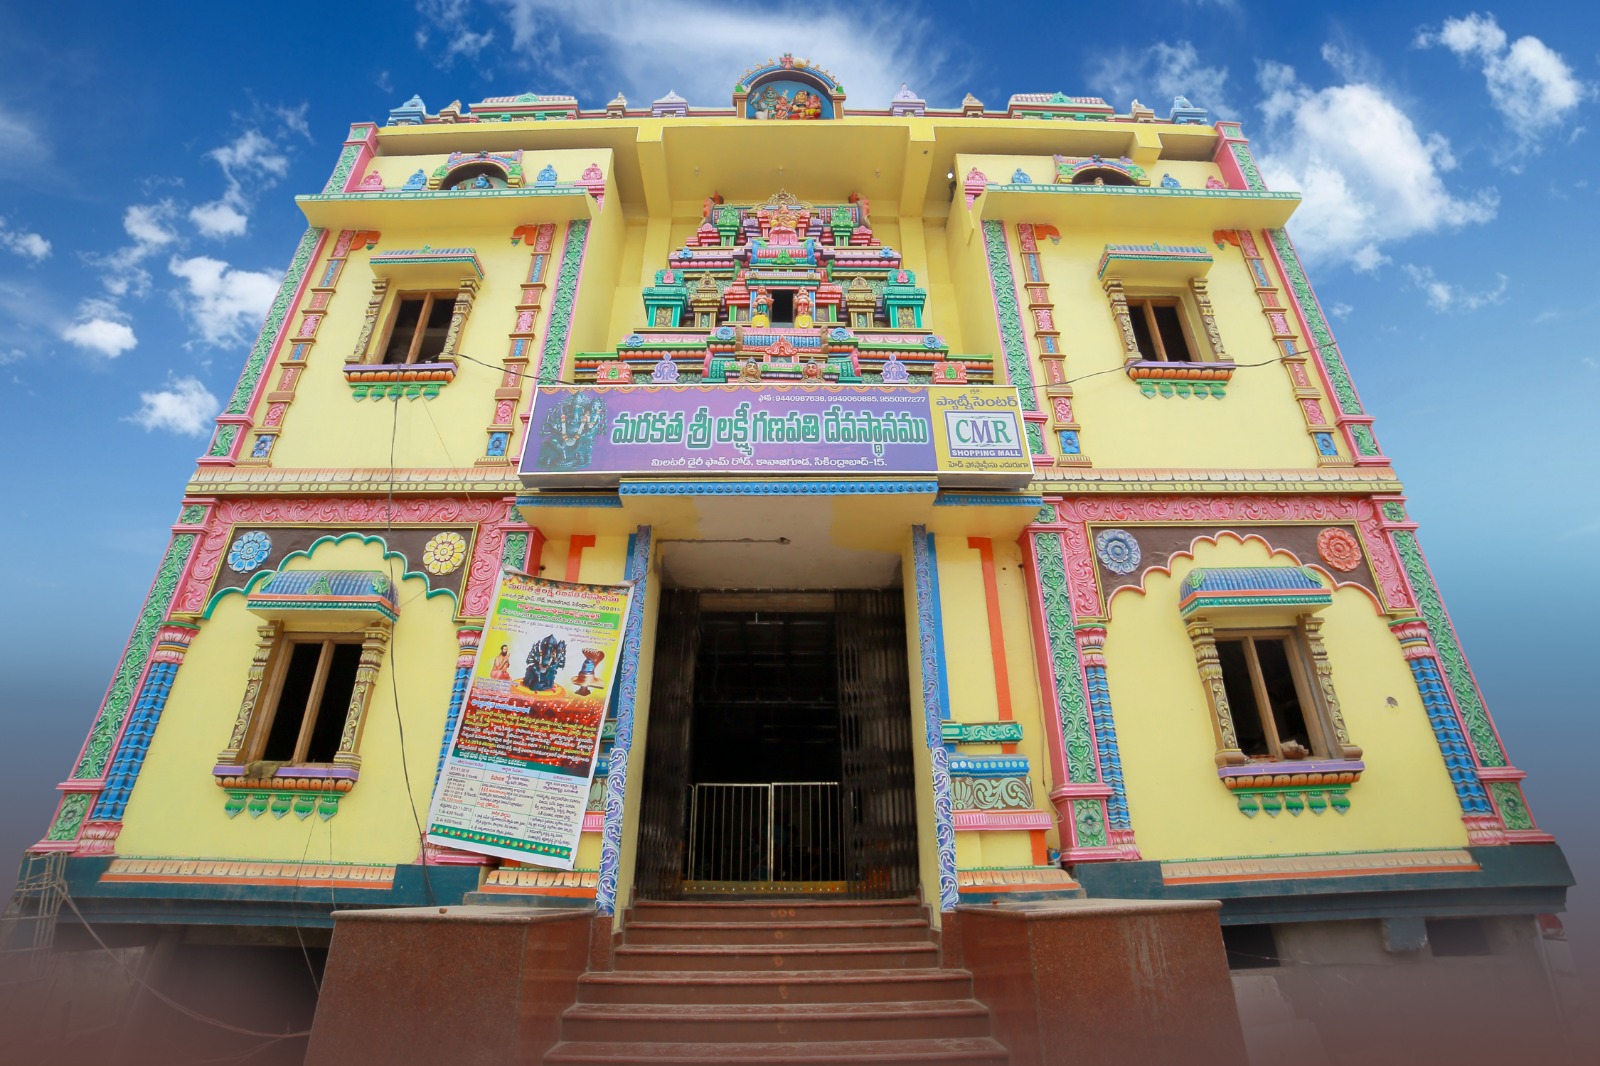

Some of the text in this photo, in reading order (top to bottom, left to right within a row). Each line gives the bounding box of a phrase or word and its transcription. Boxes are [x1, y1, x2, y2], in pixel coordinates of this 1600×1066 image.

[611, 411, 684, 444] మరకత
[686, 406, 713, 449] శ్రీ
[823, 405, 928, 456] దేవస్థానము
[955, 419, 1012, 444] CMR
